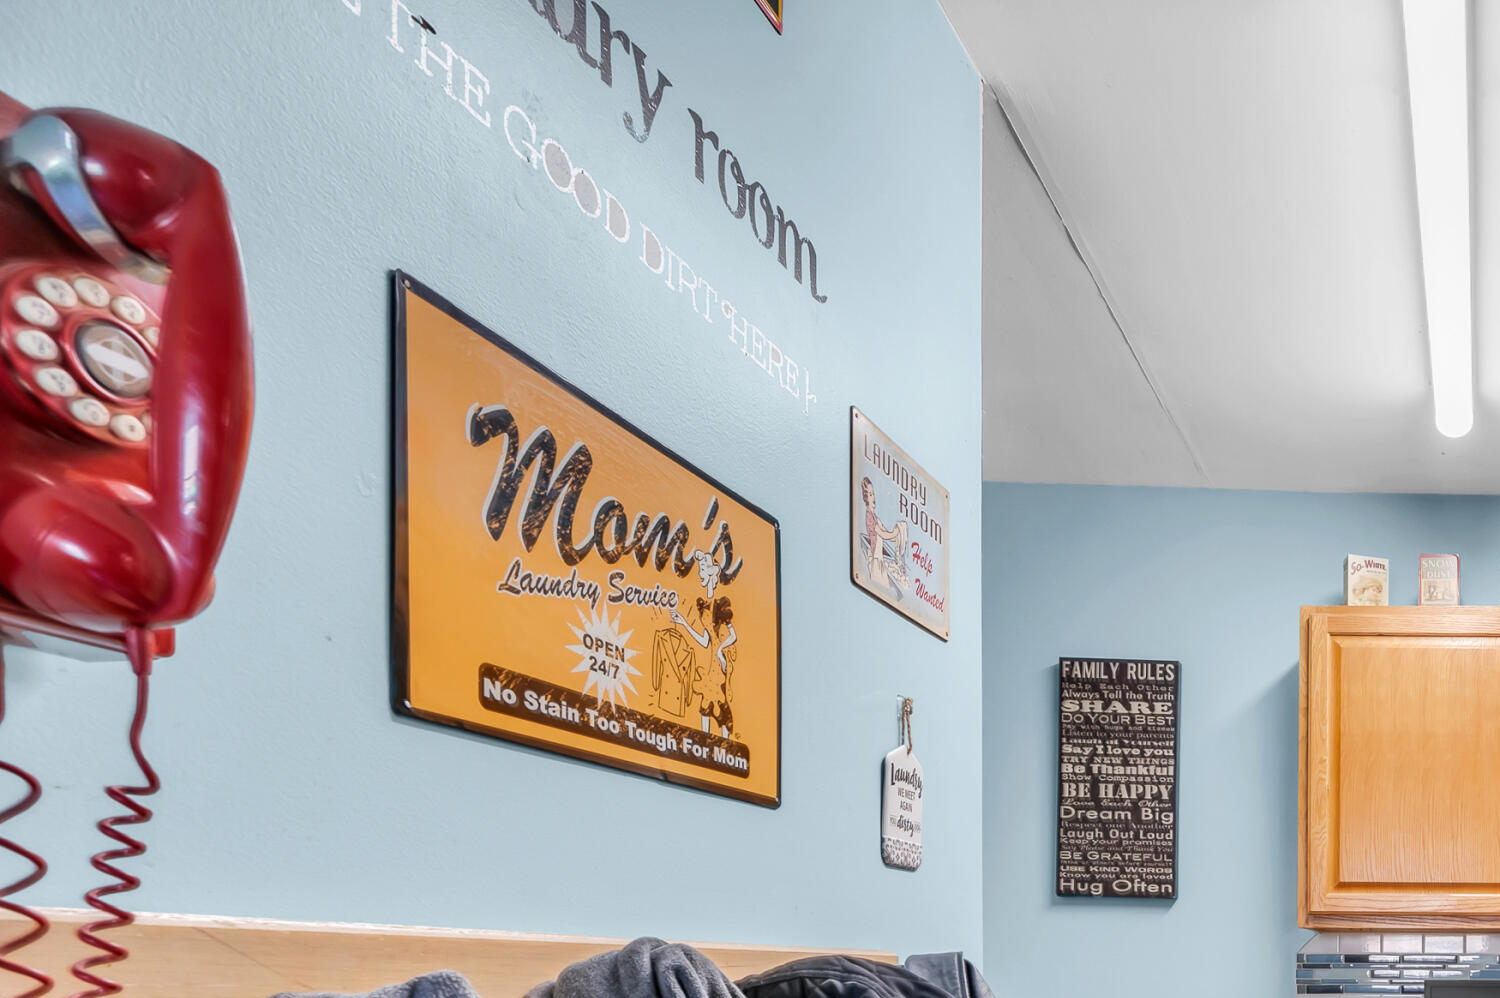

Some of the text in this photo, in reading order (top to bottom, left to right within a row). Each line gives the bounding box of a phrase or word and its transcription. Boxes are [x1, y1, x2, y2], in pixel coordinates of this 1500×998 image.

[503, 105, 630, 243] GOOD
[639, 221, 718, 324] DIRT
[688, 108, 828, 304] room
[864, 434, 927, 506] LAUNDRY
[465, 401, 744, 586] Mom's
[899, 493, 942, 545] ROOM
[911, 542, 933, 577] Help
[497, 557, 679, 611] Laundry Service
[915, 578, 944, 613] Wanted
[581, 631, 626, 664] OPEN
[588, 655, 621, 681] 24/7
[1061, 660, 1175, 681] FAMILY RULES
[1062, 690, 1174, 700] Always Tell the Truth
[1061, 700, 1173, 714] SHARE
[481, 677, 748, 771] No Stain Too Tough For Mom
[1135, 714, 1175, 725] BEST
[1062, 744, 1174, 756] Say I love you
[891, 762, 923, 799] Laundry
[1061, 763, 1174, 776] Be Thankful
[1099, 774, 1174, 783] Compassion
[1062, 783, 1172, 799] BE HAPPY
[1060, 805, 1174, 824] Dream Big
[1060, 828, 1173, 840] Laugh Out Loud
[1060, 851, 1173, 861] BE GRATEFUL
[1060, 879, 1173, 895] Hug Often
